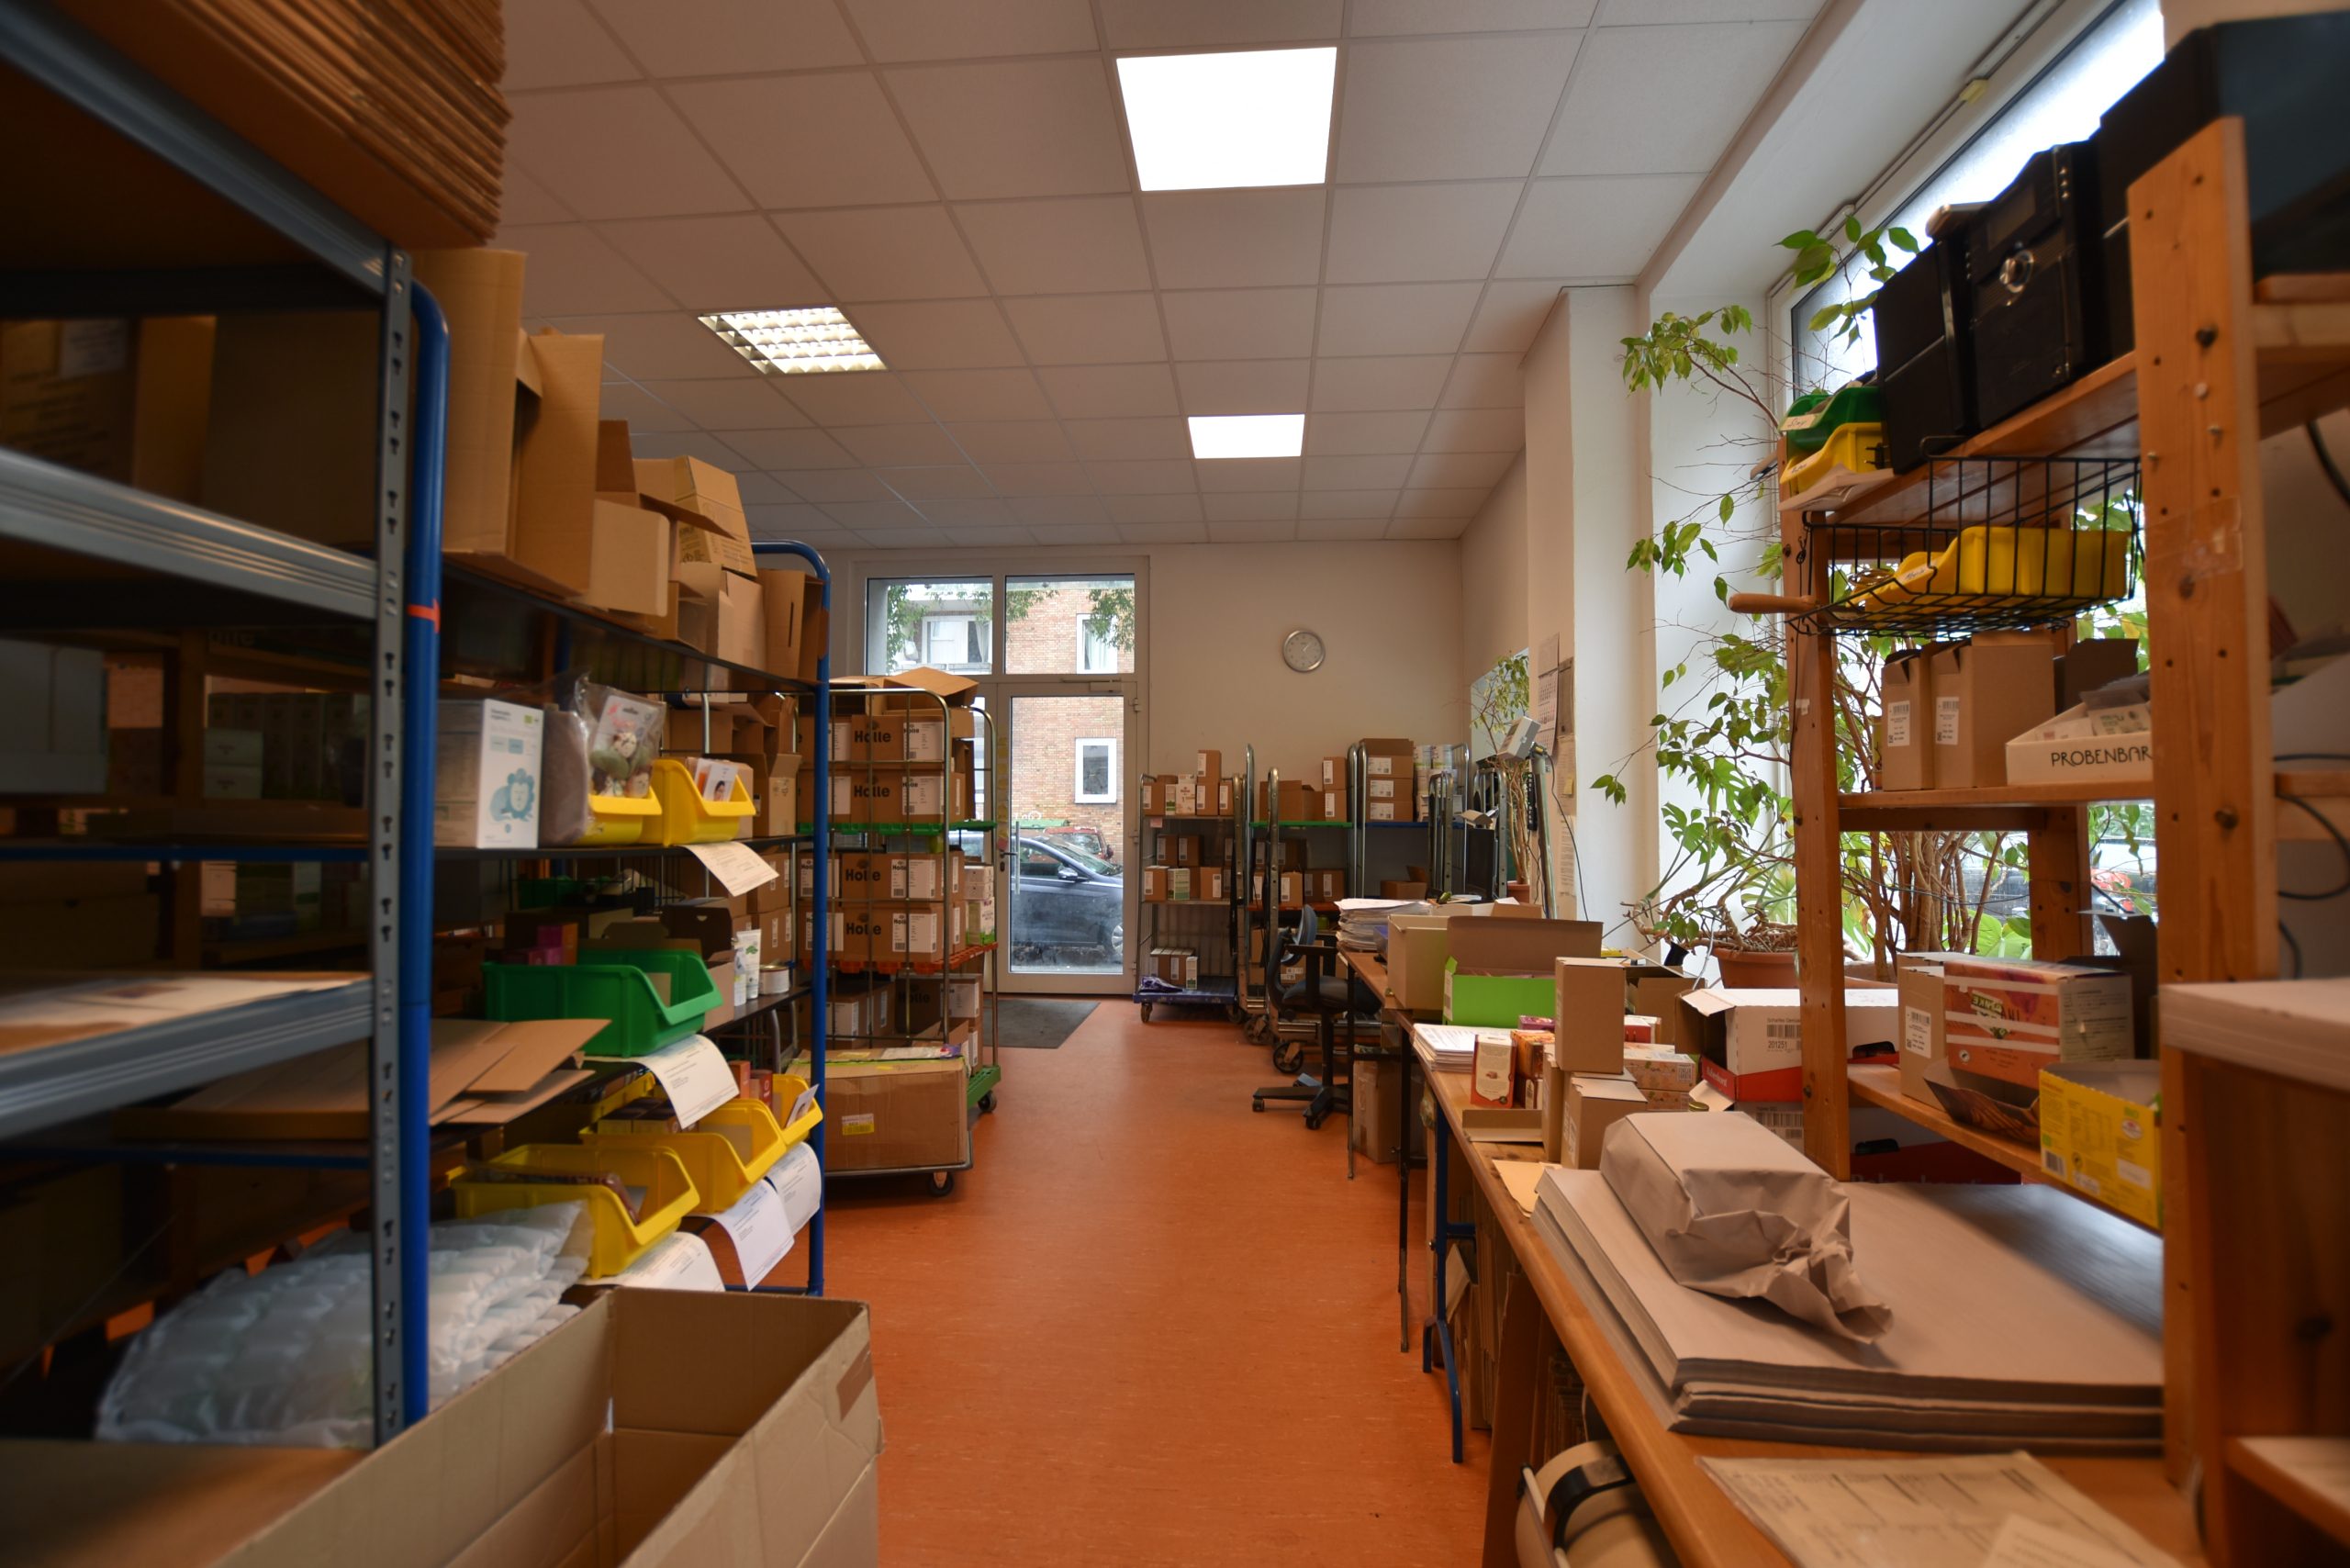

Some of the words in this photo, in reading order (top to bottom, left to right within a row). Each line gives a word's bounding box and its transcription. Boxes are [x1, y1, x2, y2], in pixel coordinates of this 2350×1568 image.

[2051, 745, 2153, 767] PROBENBAR
[845, 868, 881, 881] Hole
[846, 923, 882, 935] Hole
[1767, 1040, 1787, 1049] 201251
